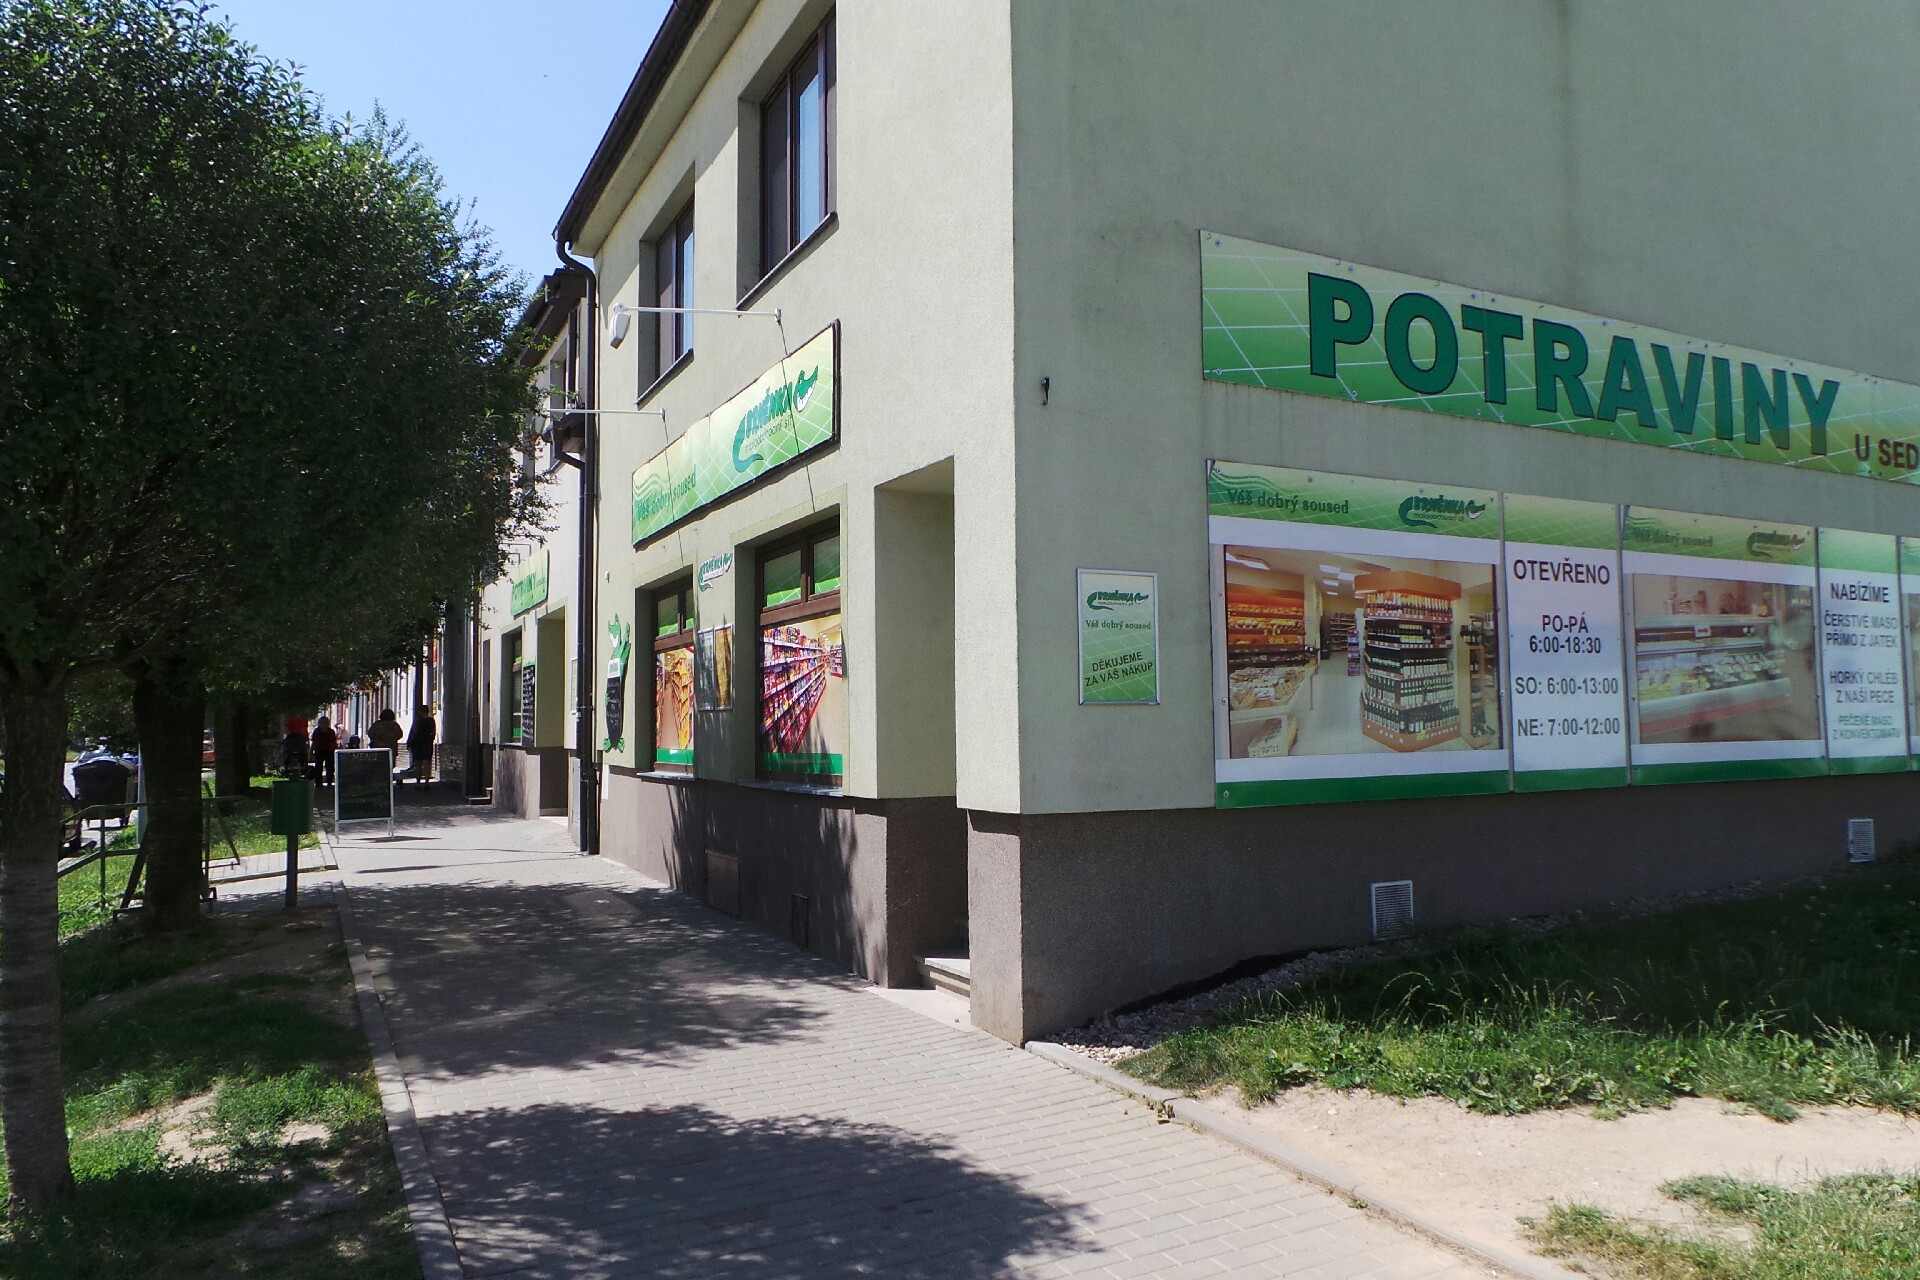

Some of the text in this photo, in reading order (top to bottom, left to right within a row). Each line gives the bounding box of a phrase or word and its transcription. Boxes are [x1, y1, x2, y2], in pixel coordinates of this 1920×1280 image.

[1307, 272, 1840, 456] POTRAVINY
[1855, 433, 1871, 462] U
[1227, 489, 1349, 515] Váš dobrý soused
[1512, 557, 1610, 586] OTEVŘENO
[1830, 581, 1890, 603] NABÍZÍME
[1085, 619, 1152, 631] Váš dobrý soused
[1541, 611, 1590, 634] PO-PÁ
[1824, 610, 1898, 630] ČERSTVÉ MASO
[1529, 636, 1602, 654] 6:00-18:30
[1826, 630, 1857, 646] PŘÍMO
[1860, 634, 1867, 647] Z
[1092, 651, 1144, 672] DĚKUJEME
[1085, 662, 1154, 688] ZA VÁŠ NÁKUP
[1829, 667, 1898, 685] HORKÝ CHLÉB
[1515, 676, 1619, 695] SO: 6:00-13:00
[1836, 690, 1843, 704] Z
[1869, 690, 1895, 704] PECE
[1517, 717, 1620, 737] NE: 7:00-12:00
